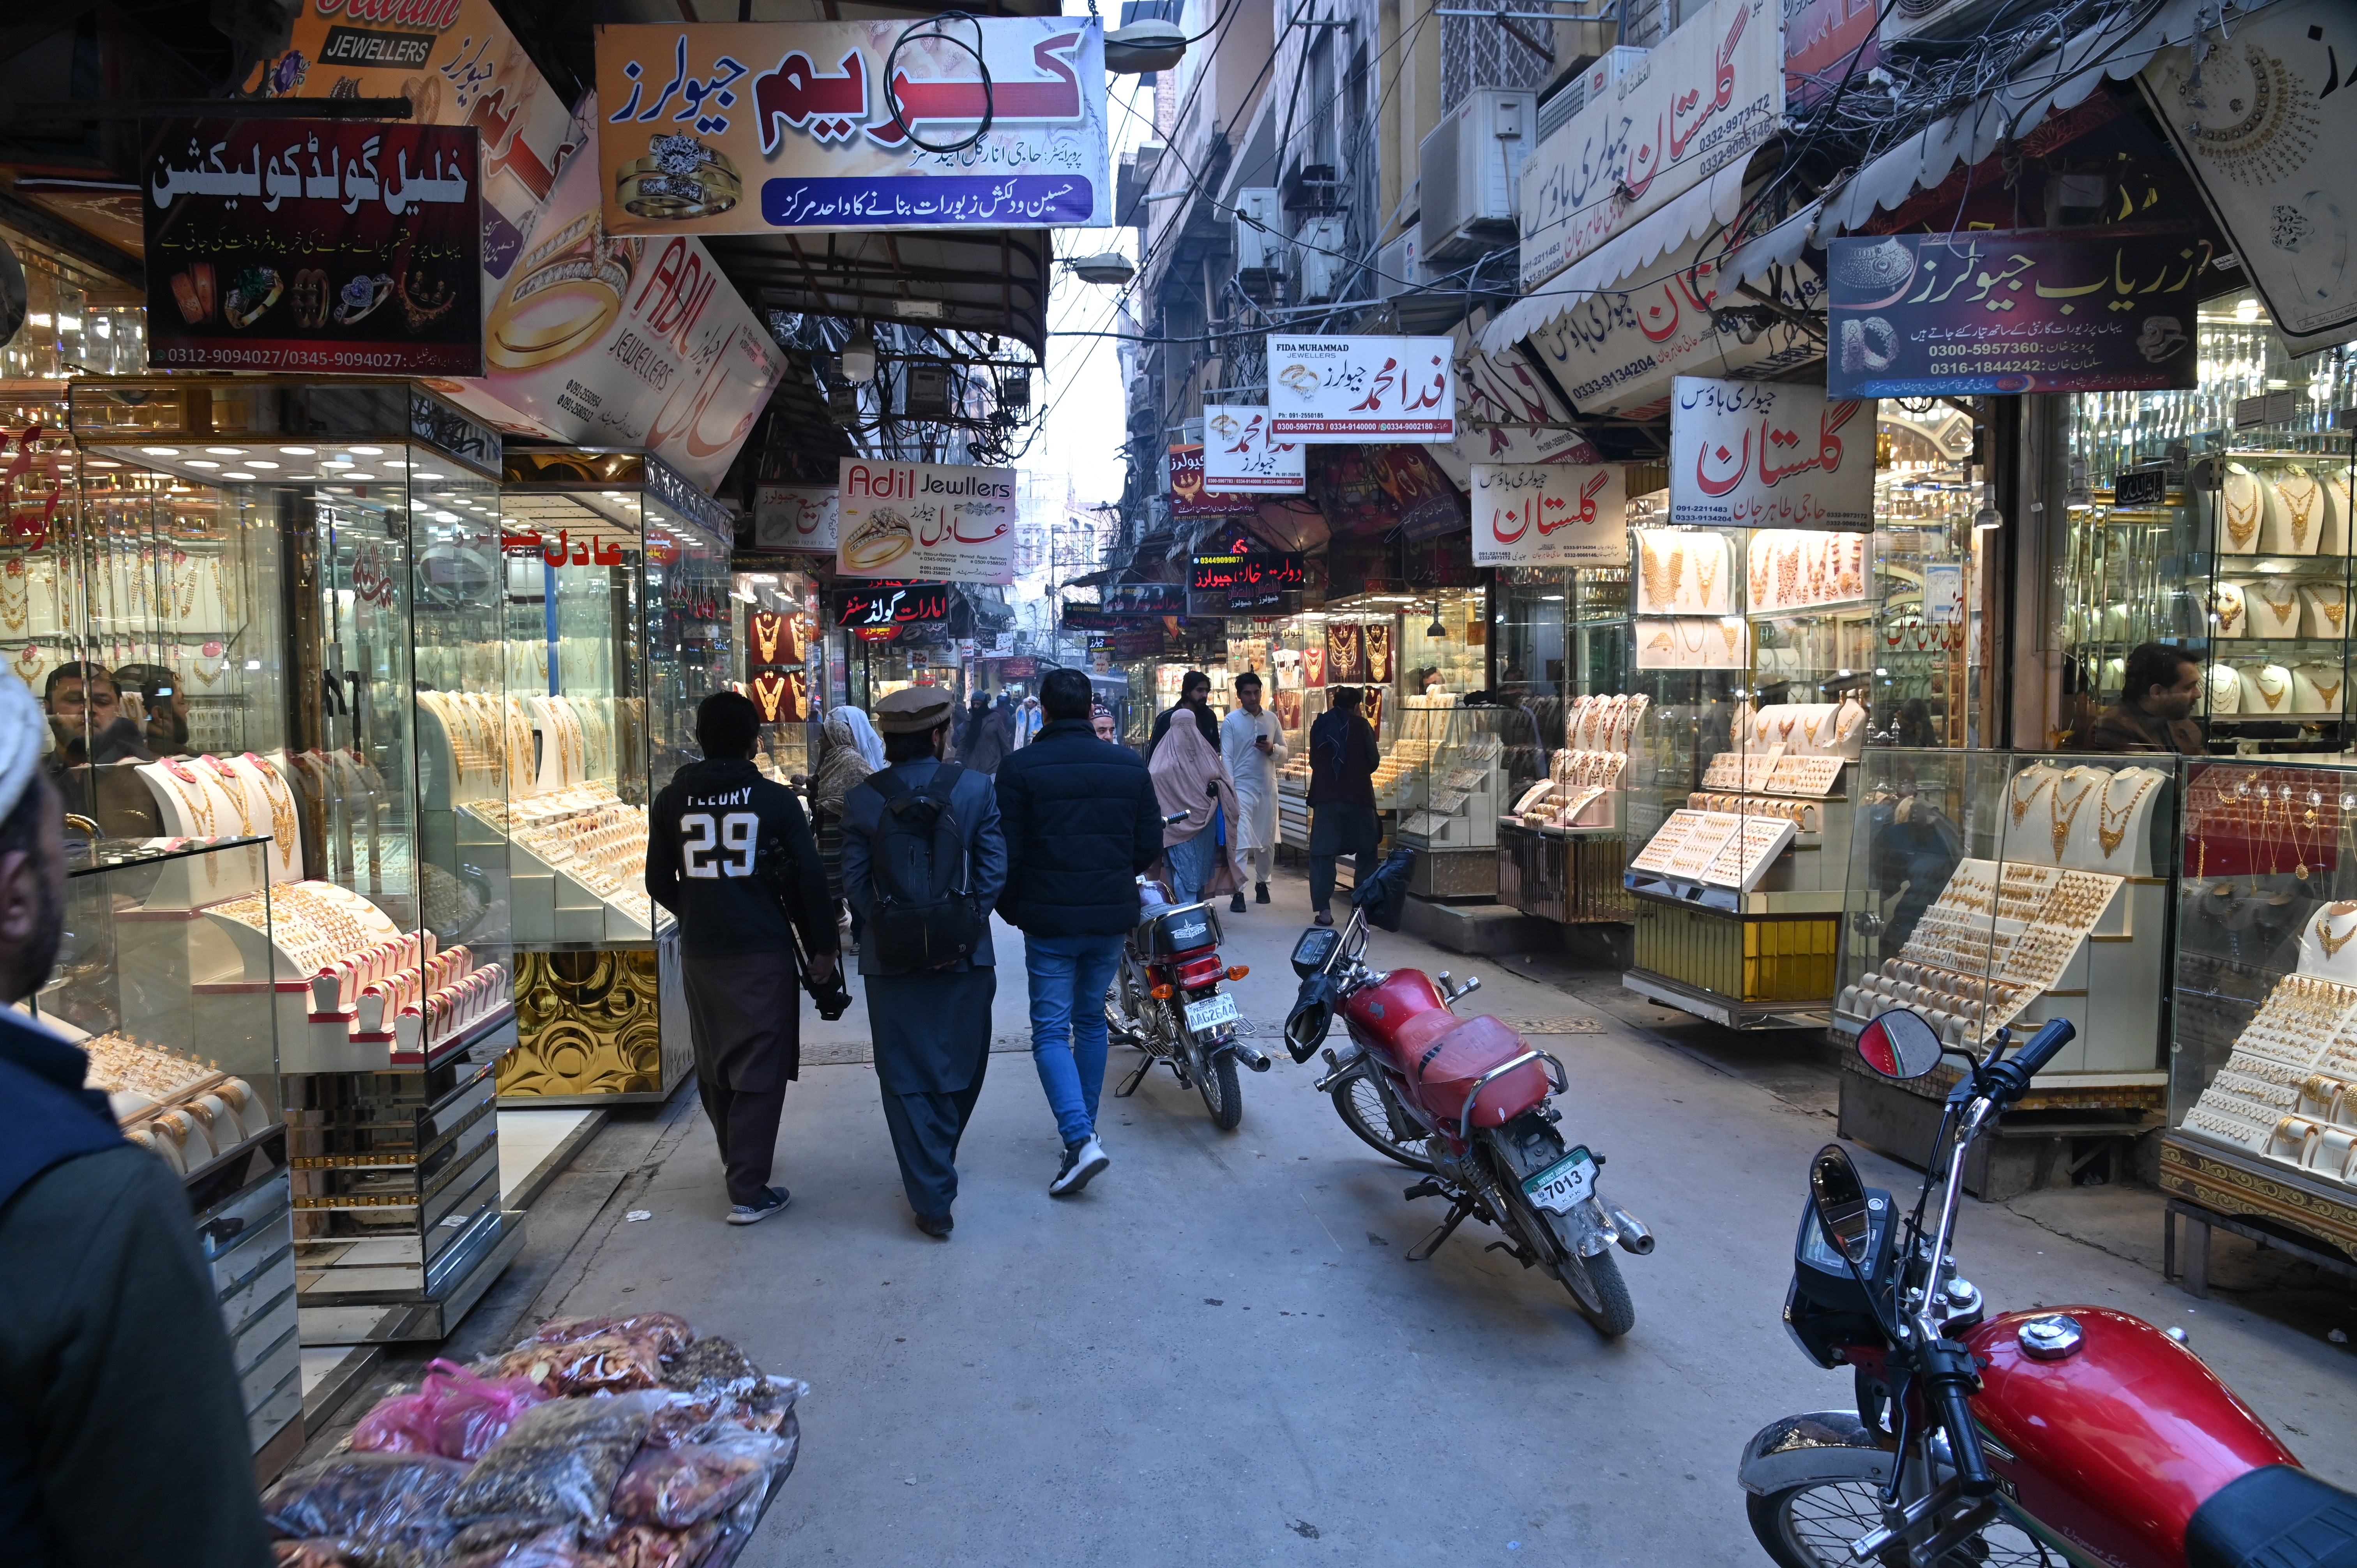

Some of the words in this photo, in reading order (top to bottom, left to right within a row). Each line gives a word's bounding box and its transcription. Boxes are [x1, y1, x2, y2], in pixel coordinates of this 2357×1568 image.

[327, 35, 428, 62] JEWELLERS
[440, 34, 493, 108] جیولرز
[609, 34, 749, 136] جیولرز
[753, 28, 1085, 154] کریم
[1700, 94, 1770, 152] 0332-9973172
[1008, 143, 1041, 170] حاجی
[1572, 114, 1633, 208] جیولری
[152, 137, 301, 212] کولیکشن
[307, 131, 380, 215] گولڈ
[385, 148, 468, 216] خلیل
[782, 187, 815, 222] مرکز
[816, 195, 850, 216] واحد
[853, 192, 869, 215] کا
[866, 189, 911, 218] بنانے
[914, 194, 977, 221] زیورات
[1027, 183, 1073, 217] حسین
[161, 237, 181, 254] ہے
[184, 222, 207, 254] جاتی
[211, 226, 227, 251] کی
[302, 228, 319, 254] کی
[316, 233, 352, 252] سونے
[352, 234, 388, 261] پرانے
[431, 240, 461, 260] یہاں
[1521, 242, 1560, 274] 091-2211483
[1908, 240, 2036, 311] جیولرز
[2035, 247, 2194, 315] زریاب
[634, 237, 717, 356] ADIL
[1910, 330, 1925, 342] ہیں
[1928, 328, 1954, 341] جاتے
[1972, 327, 1988, 339] تیار
[1987, 326, 2011, 337] ساتھ
[2010, 322, 2027, 334] کے
[2027, 321, 2051, 336] گارنٹی
[2051, 322, 2090, 334] زیورات
[2089, 324, 2097, 336] پر
[2098, 321, 2122, 334] یہاں
[168, 348, 402, 367] 0312-9094027/0345-9094027
[1929, 342, 2039, 358] 0300-5957360
[2074, 342, 2095, 354] پرویز
[1323, 358, 1366, 392] جیولرز
[1573, 355, 1656, 400] 0333-9134204
[1930, 361, 2041, 374] 0316-1844242
[2069, 359, 2103, 370] سلمان
[570, 382, 603, 408] 091-2550954
[1348, 357, 1397, 411] محمد
[1401, 355, 1445, 411] فدا
[561, 396, 594, 422] 091-2580512
[1681, 385, 1724, 416] ہاؤس
[1726, 384, 1777, 415] جیولری
[1224, 414, 1263, 453] محمد
[1277, 423, 1324, 431] 0300-5967783
[1329, 423, 1376, 431] 0334-9140000
[1696, 399, 1862, 498] گلستان
[1241, 451, 1277, 475] جیولرز
[848, 465, 915, 499] Adil
[921, 472, 1011, 498] Jewllers
[1480, 471, 1509, 492] ہاؤس
[1512, 469, 1547, 489] جیولری
[762, 489, 798, 504] جیولرز
[1493, 469, 1610, 545] گلستان
[1676, 505, 1728, 513] 091-2211483
[1733, 495, 1762, 525] جان
[1761, 496, 1792, 523] طاہر
[1794, 494, 1826, 524] حاجی
[910, 502, 936, 523] جیولرز
[920, 504, 1010, 547] عادل
[1676, 514, 1732, 523] 0333-9134204
[544, 528, 623, 567] عادل
[1195, 568, 1233, 588] جیولرز
[1269, 558, 1302, 582] دولت
[1412, 561, 1444, 583] جیولرز
[839, 596, 868, 625] سنٹر
[864, 590, 906, 623] گولڈ
[895, 596, 945, 621] امارات
[1230, 599, 1252, 608] جیولرز
[1258, 595, 1279, 605] جیولرز
[1089, 636, 1104, 648] جیولرز
[679, 811, 760, 879] 29
[1193, 928, 1206, 936] STAR
[1537, 1173, 1555, 1187] DISTRICT
[1555, 1160, 1574, 1177] JUDICIARY
[1544, 1170, 1583, 1199] 7013
[2062, 1526, 2105, 1557] Urgent
